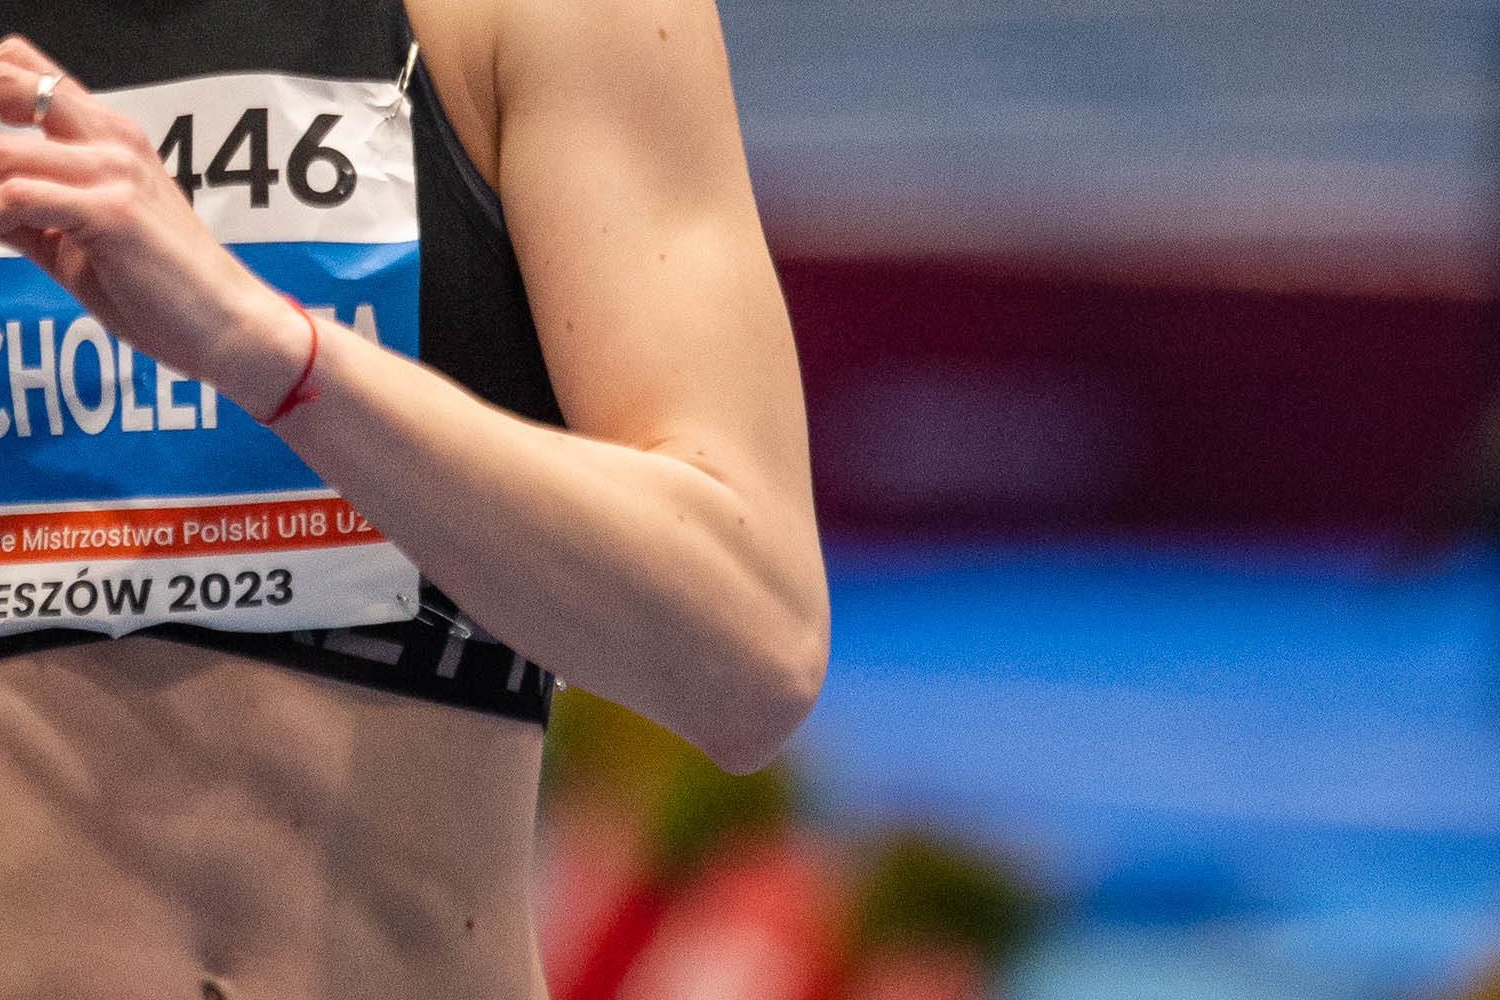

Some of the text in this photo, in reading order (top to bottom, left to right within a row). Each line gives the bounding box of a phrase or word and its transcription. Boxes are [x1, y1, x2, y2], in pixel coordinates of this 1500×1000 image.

[22, 524, 174, 551] Mistrzostwa
[182, 514, 269, 545] Polski
[277, 511, 328, 538] U18
[336, 510, 373, 534] U2
[167, 568, 294, 614] 2023
